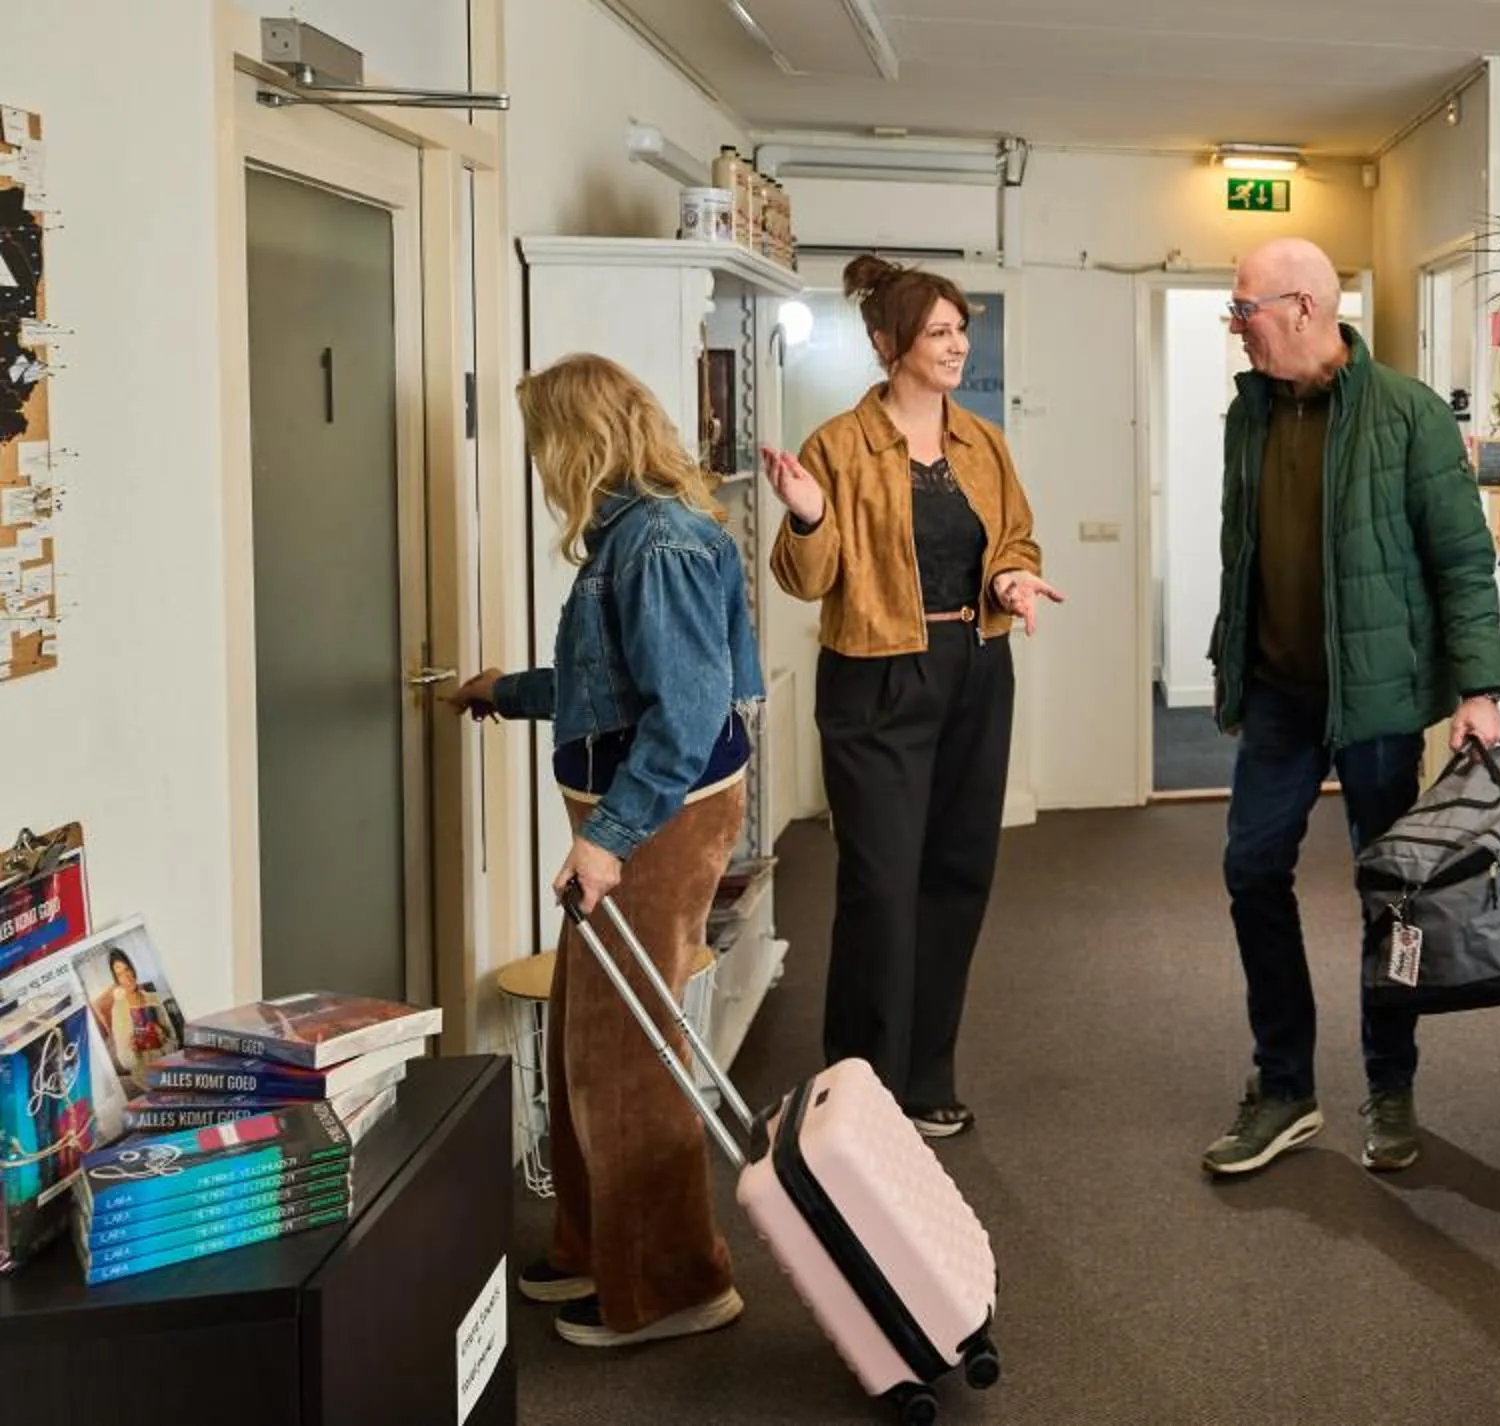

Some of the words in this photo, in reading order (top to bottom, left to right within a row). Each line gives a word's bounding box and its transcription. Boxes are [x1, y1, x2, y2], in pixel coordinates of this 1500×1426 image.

[159, 1071, 193, 1090] ALLES
[194, 1073, 226, 1091] KOMT
[227, 1075, 257, 1093] GOED
[136, 1110, 175, 1128] ALLES
[179, 1110, 215, 1127] KOMT
